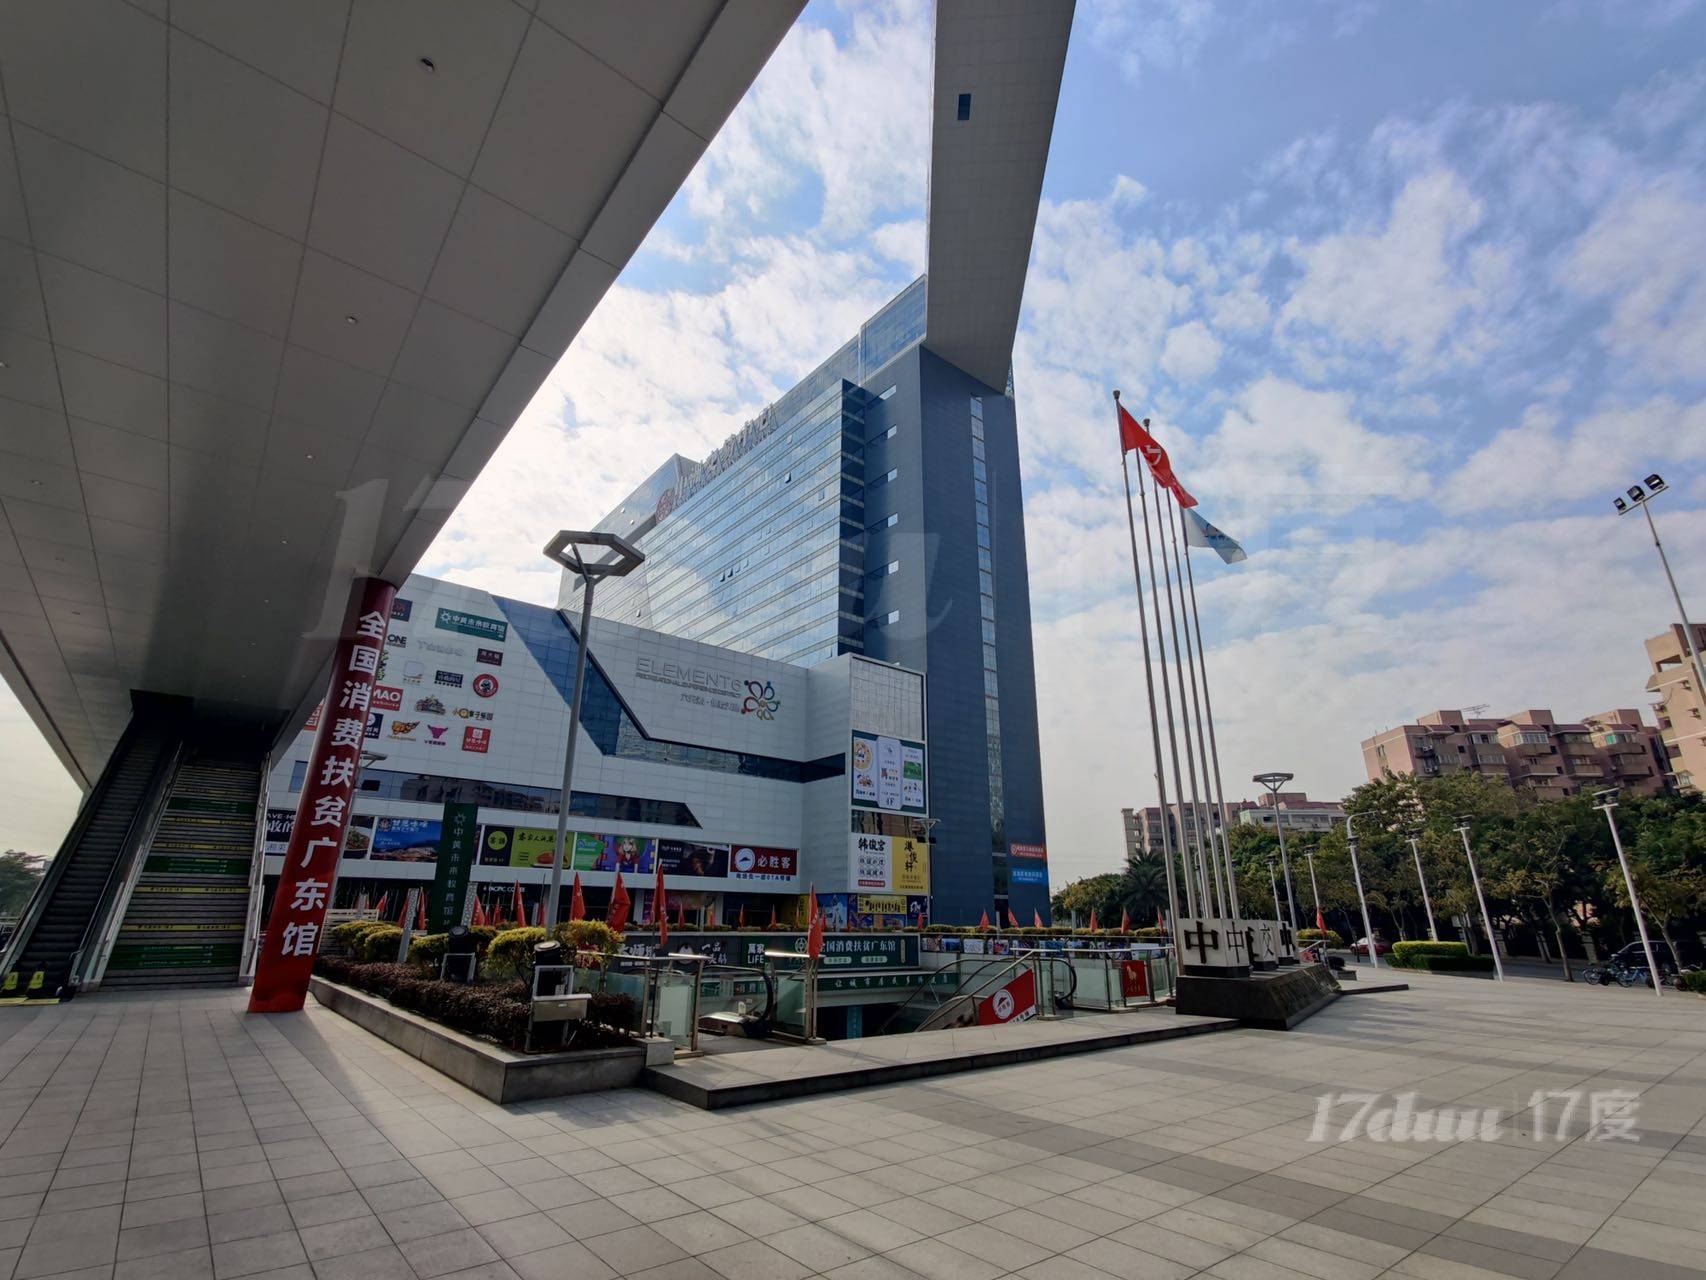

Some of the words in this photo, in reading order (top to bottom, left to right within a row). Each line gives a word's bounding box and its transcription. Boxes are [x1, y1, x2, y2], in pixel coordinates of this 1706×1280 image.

[280, 609, 387, 957] 全国消费扶贫广东馆
[757, 855, 791, 869] 必胜客
[748, 955, 765, 964] LIFE
